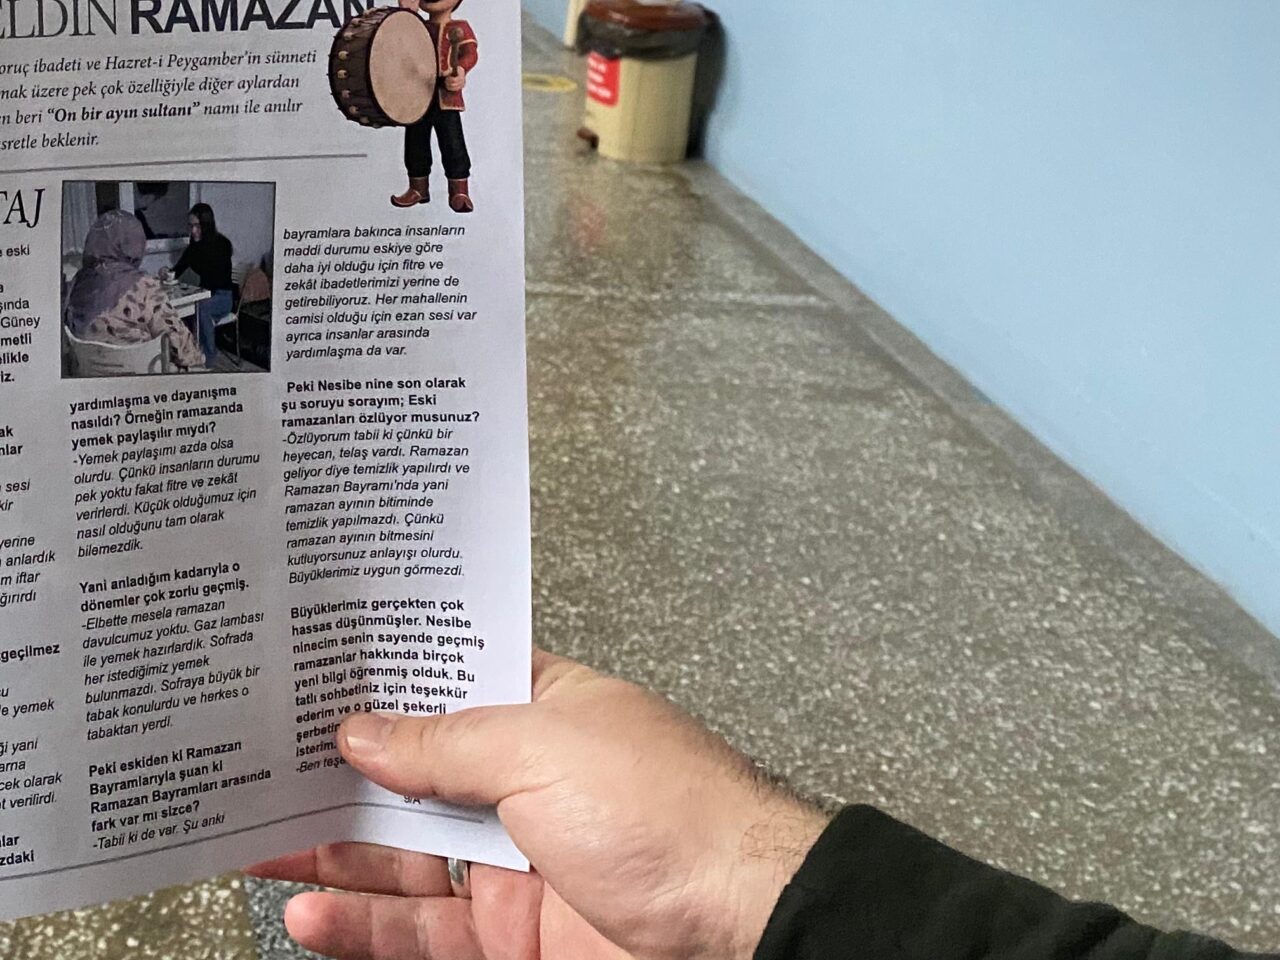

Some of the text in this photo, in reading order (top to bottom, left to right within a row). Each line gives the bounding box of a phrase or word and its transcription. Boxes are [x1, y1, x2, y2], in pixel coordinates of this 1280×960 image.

[33, 57, 81, 73] ibadeti
[86, 60, 101, 70] ve
[105, 55, 163, 70] Hazret-i
[264, 50, 317, 64] sünneti
[31, 84, 69, 98] üzere
[71, 81, 97, 101] pek
[101, 80, 124, 99] çok
[128, 77, 195, 97] özelliğiyle
[199, 76, 234, 95] diğer
[237, 74, 299, 94] aylardan
[15, 109, 43, 124] beri
[81, 106, 103, 121] bir
[105, 108, 138, 124] ayın
[204, 104, 239, 115] namı
[244, 99, 260, 114] ile
[264, 98, 303, 113] anılır
[41, 132, 99, 148] beklenir.
[283, 225, 465, 242] bayramlara bakınca insanların
[6, 244, 30, 257] eski
[283, 241, 443, 257] maddi durumu eskiye göre
[287, 377, 466, 393] Peki Nesibe nine son olarak
[69, 387, 237, 415] yardımlaşma ve dayanışma
[281, 394, 436, 414] şu soruyu sorayım; Eski
[71, 401, 243, 431] nasıldı? Örneğin ramazanda
[282, 411, 480, 427] ramazanları özlüyor musunuz?
[71, 421, 216, 451] yemek paylaşılır mıydı?
[295, 682, 468, 706] tatlı sohbetiniz için teşekkür
[296, 699, 447, 724] ederim ve o güzel şekerli
[89, 741, 242, 777] Peki eskiden ki Ramazan
[89, 760, 223, 796] Bayramlarıyla şuan ki
